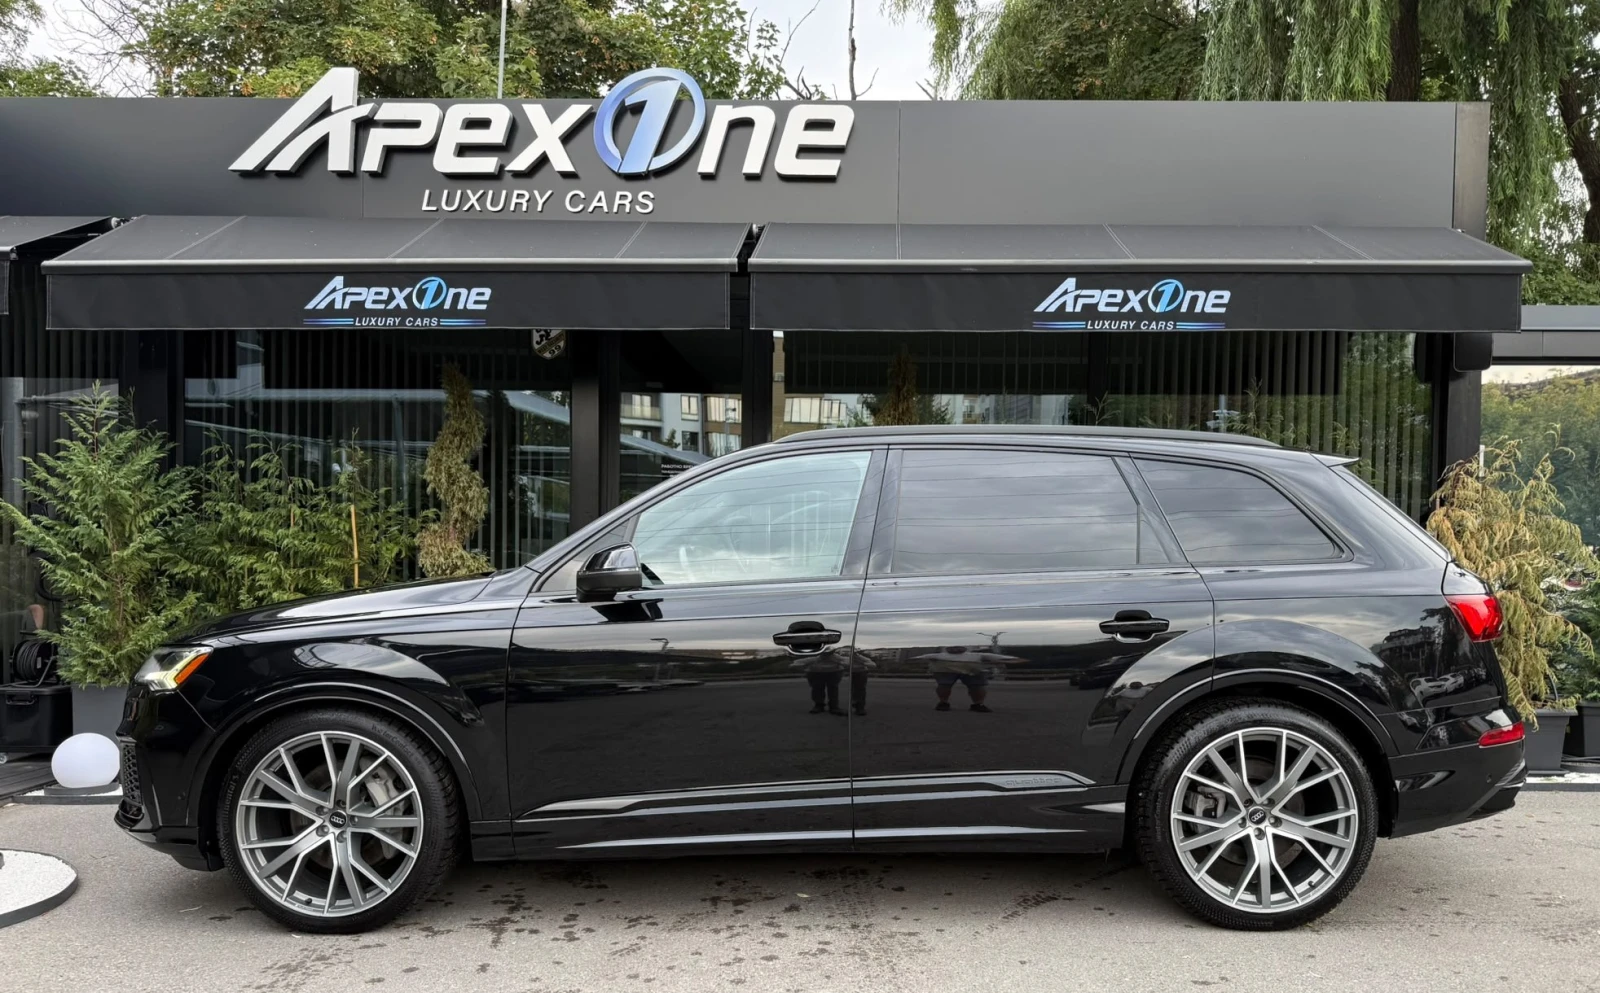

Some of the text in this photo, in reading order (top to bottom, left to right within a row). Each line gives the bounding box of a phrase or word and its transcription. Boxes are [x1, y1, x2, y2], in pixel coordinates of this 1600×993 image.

[421, 189, 656, 214] LUXURY CARS
[355, 317, 439, 327] LUXURY CARS
[1087, 320, 1175, 330] LUXURY CARS
